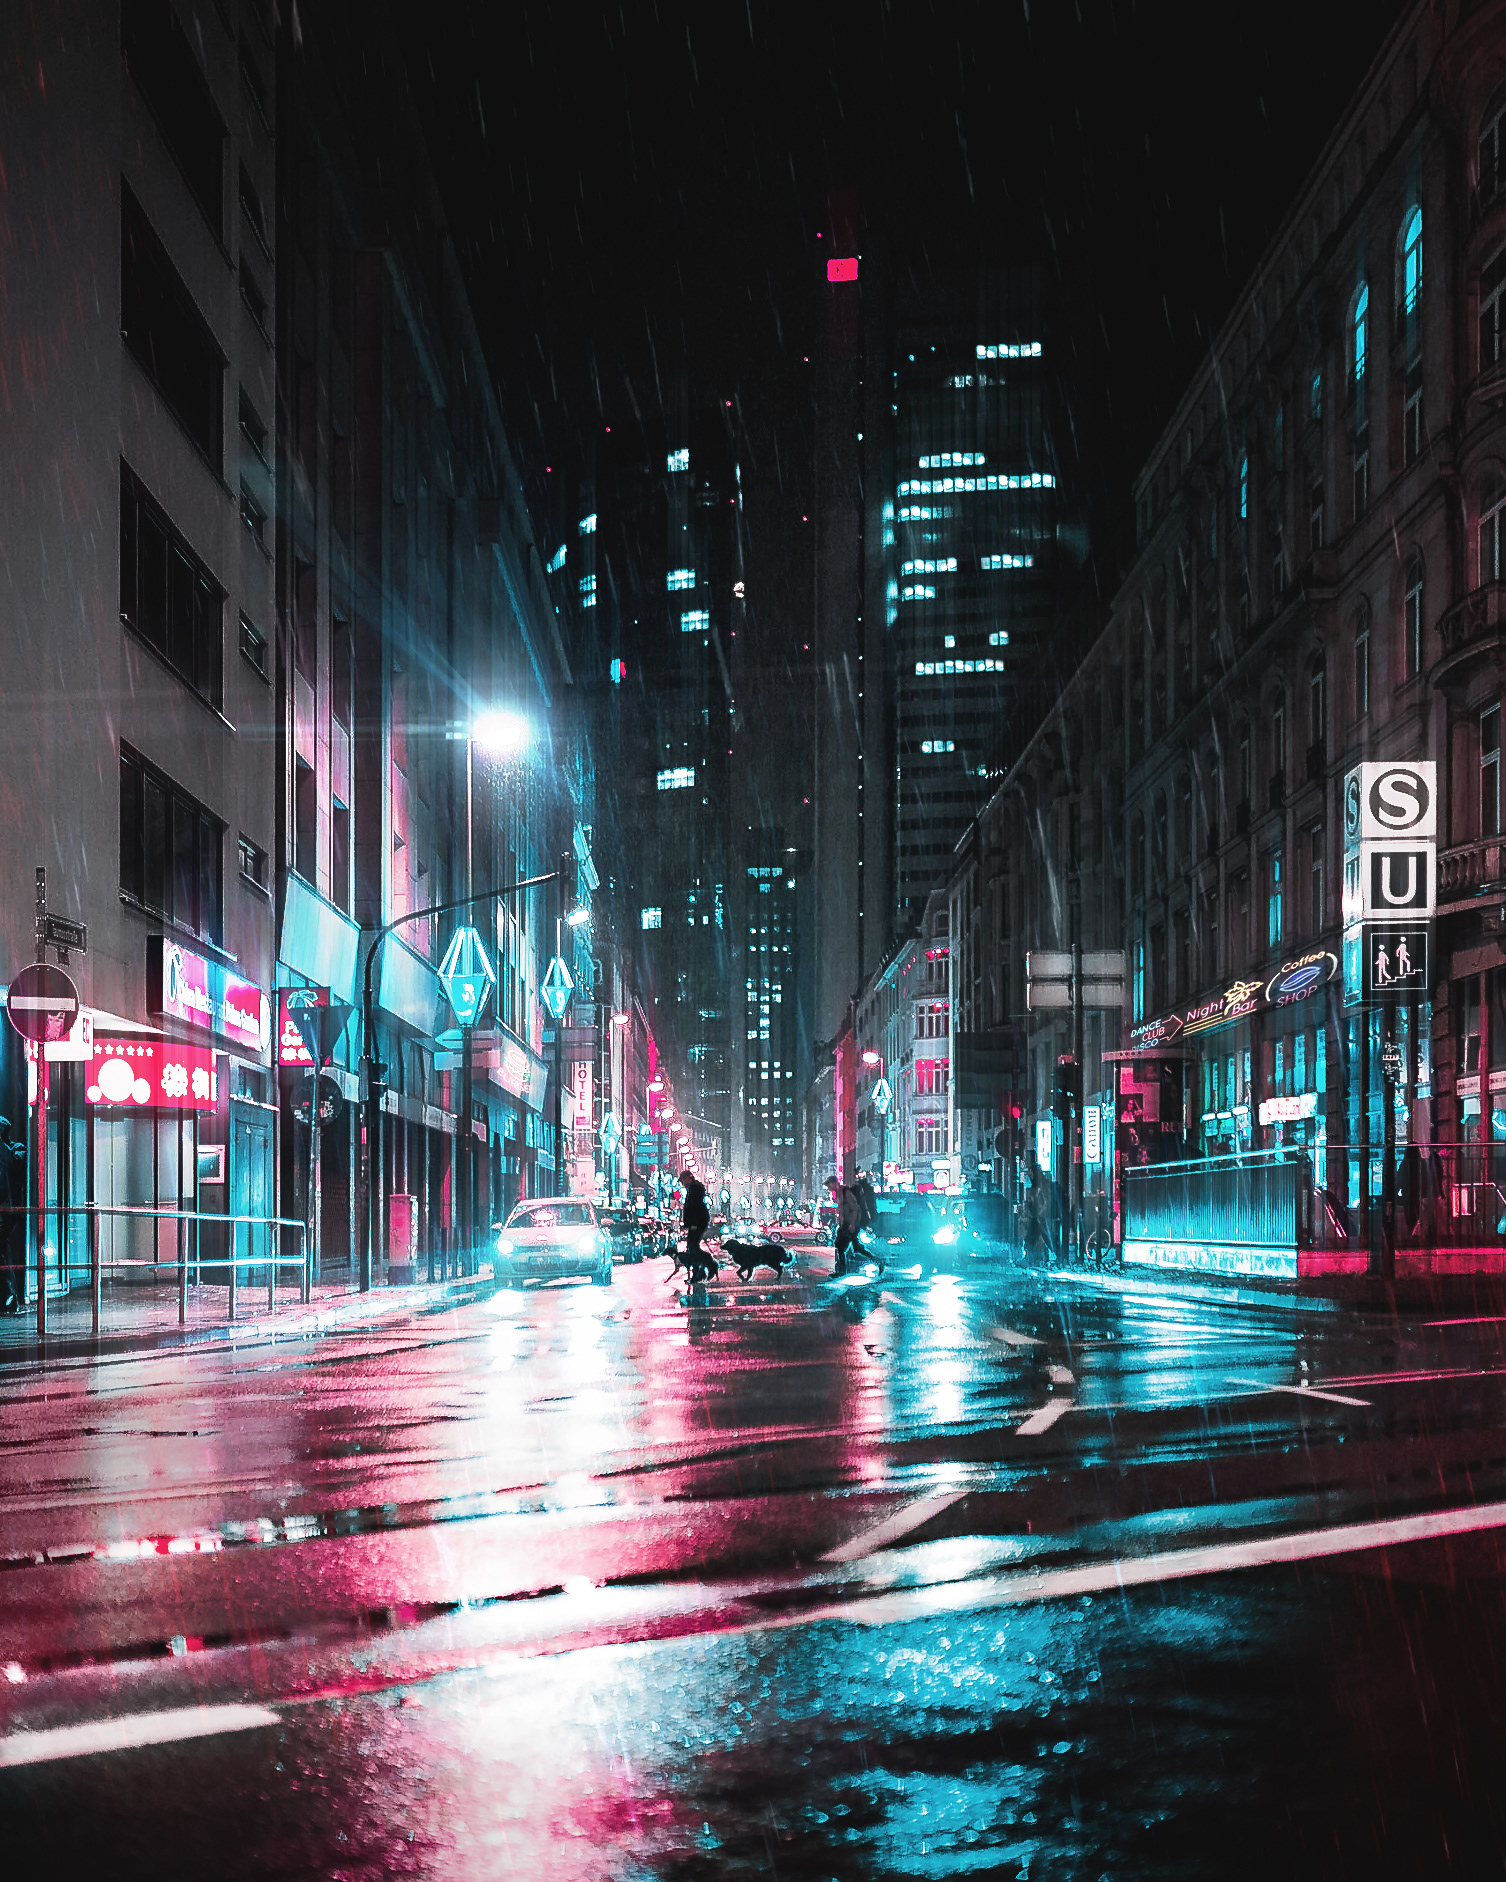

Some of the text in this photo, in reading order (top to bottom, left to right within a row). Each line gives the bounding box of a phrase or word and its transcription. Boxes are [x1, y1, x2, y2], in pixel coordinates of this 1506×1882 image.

[1378, 773, 1420, 826] S
[1381, 856, 1416, 905] U
[1281, 951, 1326, 973] Coffee
[1275, 985, 1318, 1008] SHOP
[1186, 998, 1258, 1022] Night Bar
[1130, 1018, 1162, 1038] DANCE
[1142, 1026, 1165, 1042] CLUB
